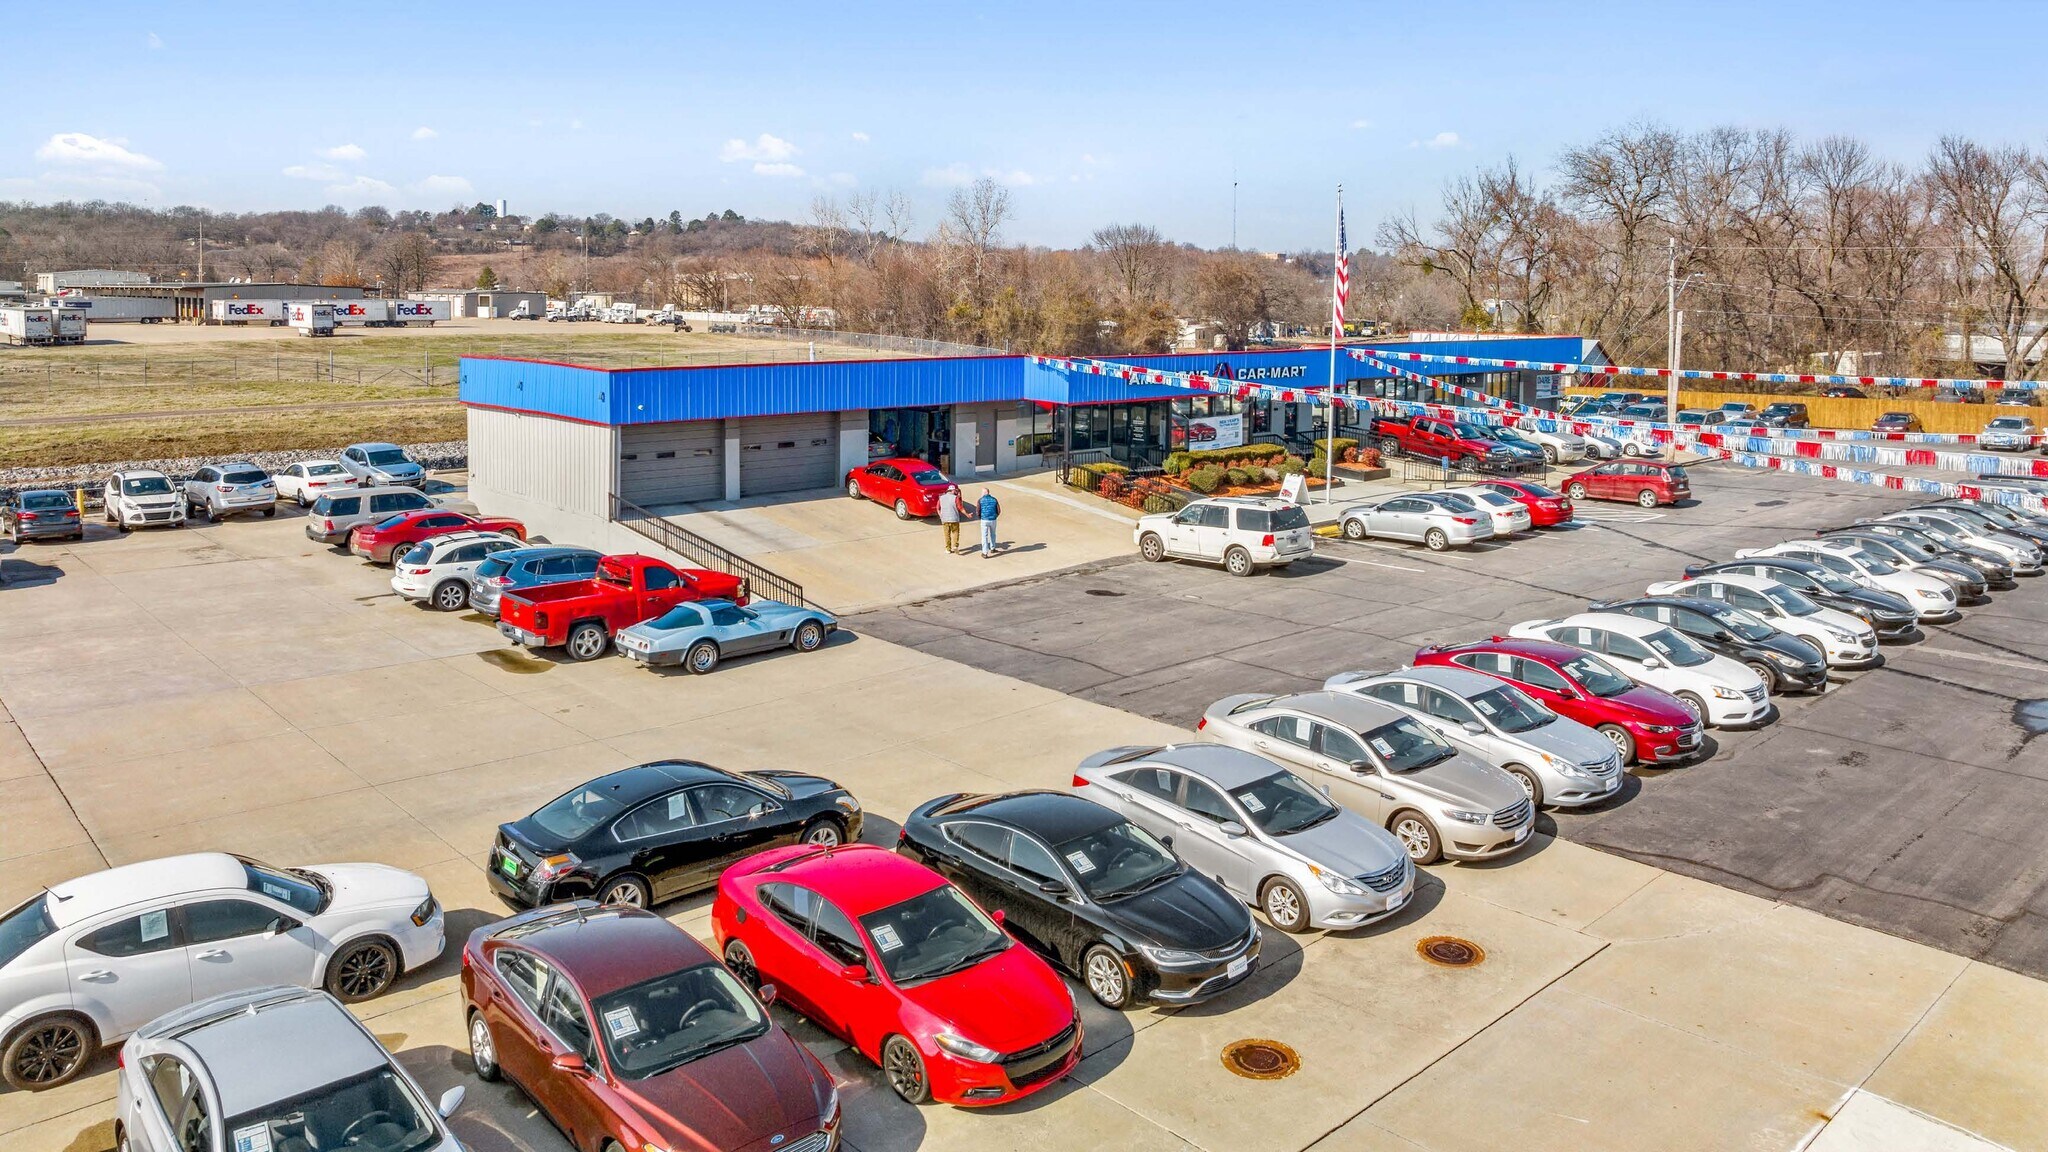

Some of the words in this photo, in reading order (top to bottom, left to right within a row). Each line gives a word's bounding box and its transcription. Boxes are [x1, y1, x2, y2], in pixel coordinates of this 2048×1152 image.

[229, 304, 264, 314] FedEx
[397, 304, 433, 315] FedEx
[1238, 366, 1307, 380] CAR-MART
